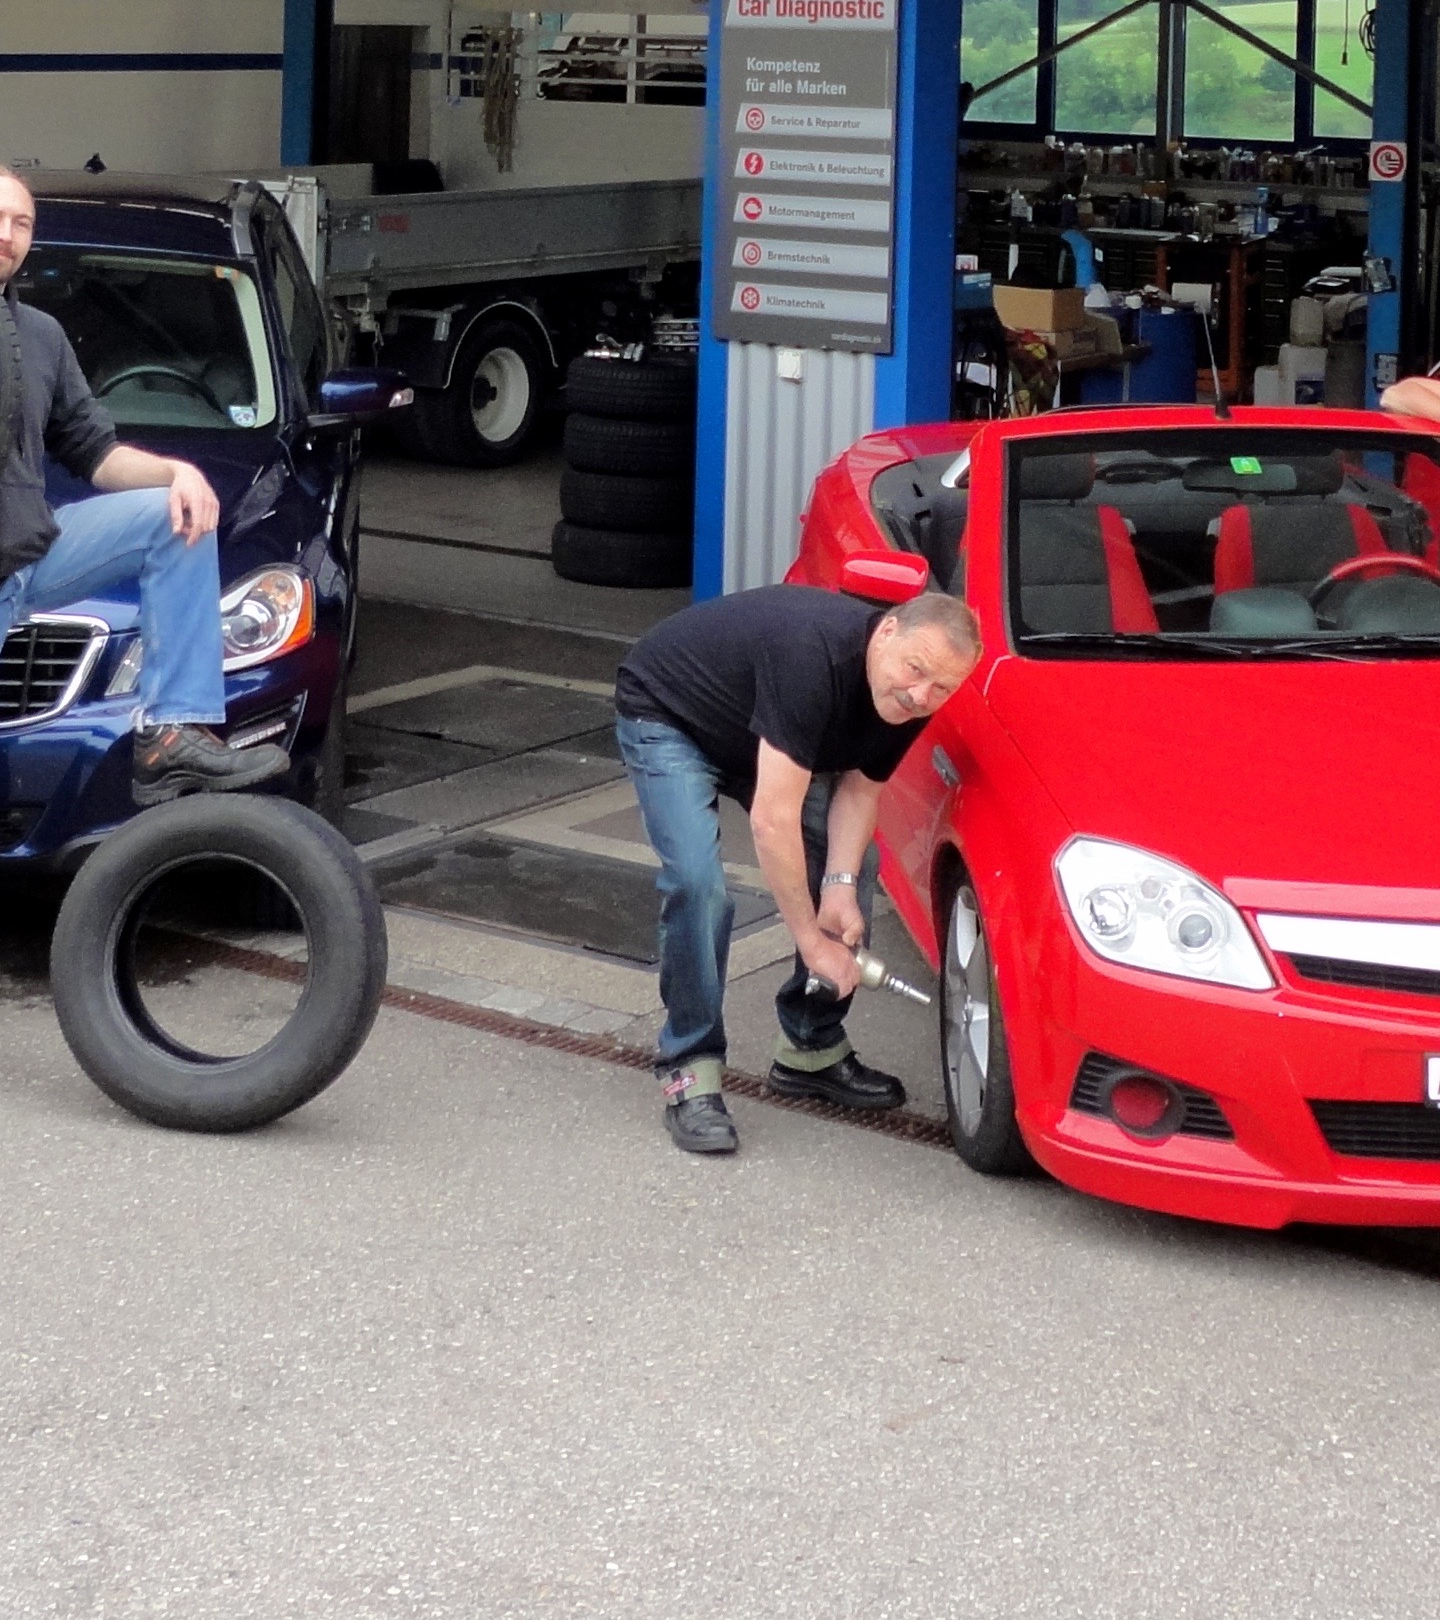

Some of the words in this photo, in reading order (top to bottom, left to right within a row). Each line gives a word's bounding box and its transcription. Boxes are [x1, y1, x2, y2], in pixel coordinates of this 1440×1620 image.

[746, 57, 820, 75] Kompetenz
[746, 78, 765, 93] für
[769, 78, 793, 93] alle
[797, 80, 847, 95] Marken
[771, 115, 805, 126] Service
[807, 117, 813, 127] &
[815, 117, 861, 130] Reparatur
[770, 160, 816, 172] Elektronik
[818, 163, 824, 173] &
[827, 163, 885, 178] Beleuchtung
[768, 205, 855, 221] Motormanagement
[767, 250, 830, 265] Bremstechnik
[766, 295, 826, 310] Klimatechnik
